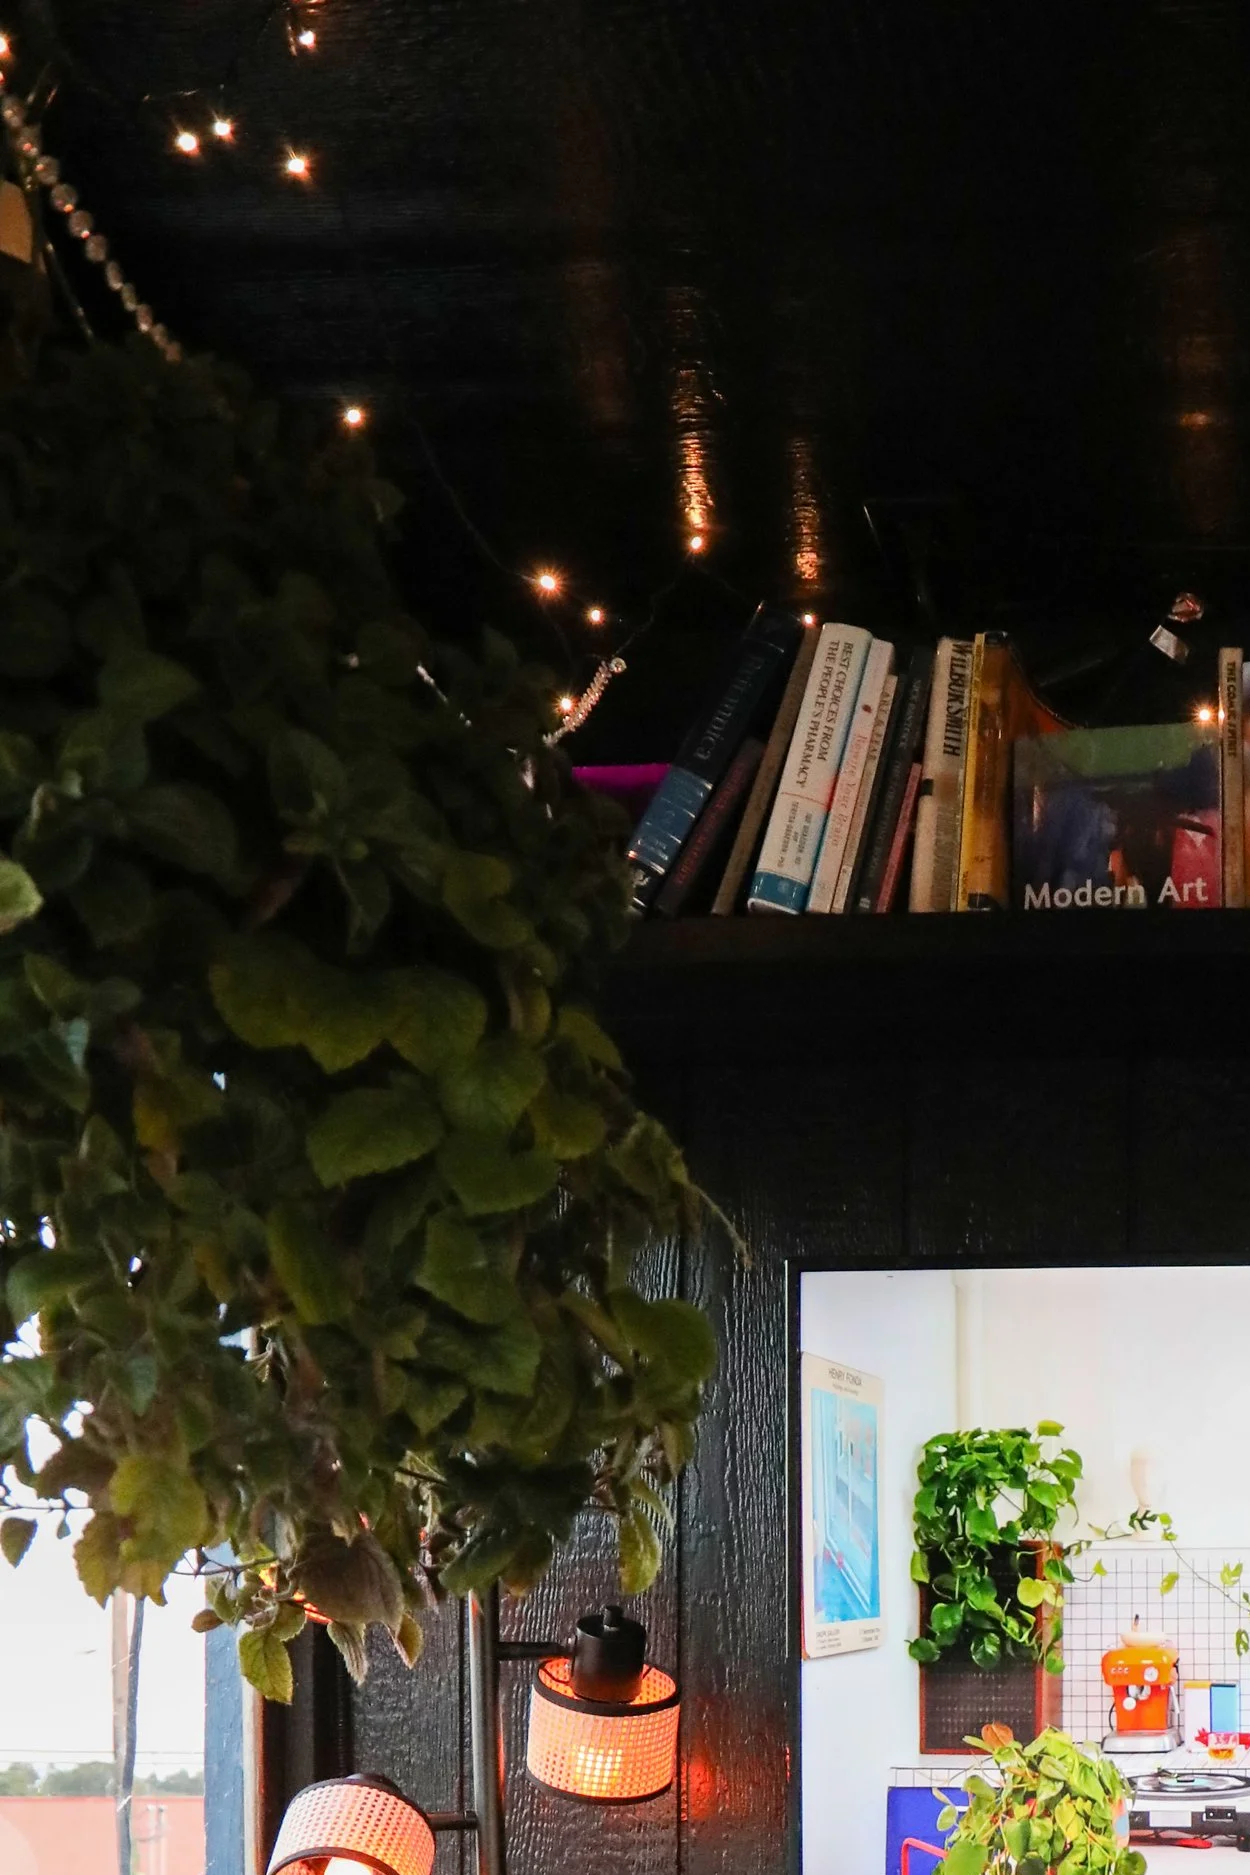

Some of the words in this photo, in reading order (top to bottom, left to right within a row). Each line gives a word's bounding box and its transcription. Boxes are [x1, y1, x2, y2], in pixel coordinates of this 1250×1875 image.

[824, 640, 839, 663] THE
[838, 641, 853, 668] BEST
[946, 643, 972, 705] WILBUR
[1226, 662, 1235, 682] THE
[811, 664, 833, 719] PEOPLE'S
[825, 669, 847, 723] CHOICES
[878, 691, 890, 713] ART
[1226, 684, 1235, 719] COMIC
[816, 724, 834, 761] FROM
[866, 732, 881, 760] FEAR
[942, 705, 966, 756] SMITH
[794, 719, 820, 787] PHARMACY
[840, 781, 856, 809] Your
[1025, 879, 1145, 909] Modern
[1157, 876, 1208, 902] Art
